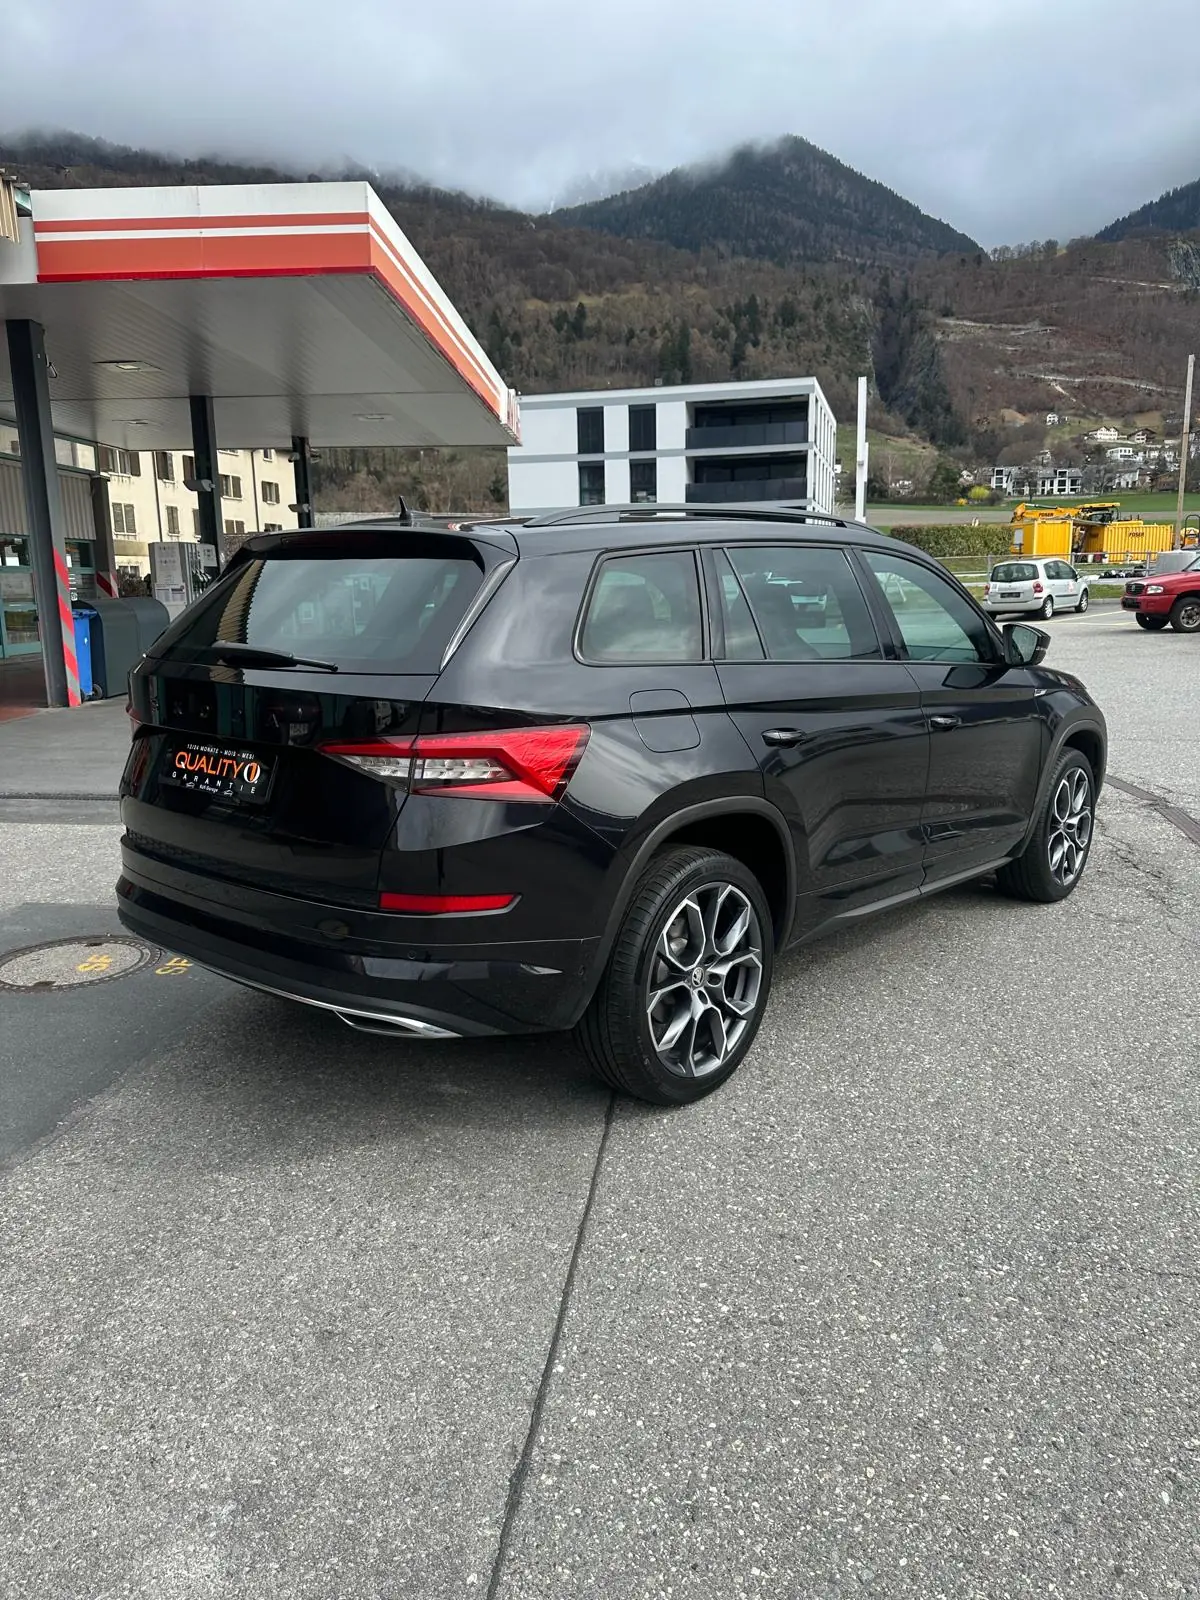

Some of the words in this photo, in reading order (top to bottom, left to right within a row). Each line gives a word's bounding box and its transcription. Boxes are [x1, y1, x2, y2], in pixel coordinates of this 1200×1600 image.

[200, 745, 219, 754] MONATE
[224, 749, 236, 757] MOIS
[241, 752, 255, 760] MESI
[175, 751, 244, 779] QUALITY
[172, 771, 256, 794] GARANTIE
